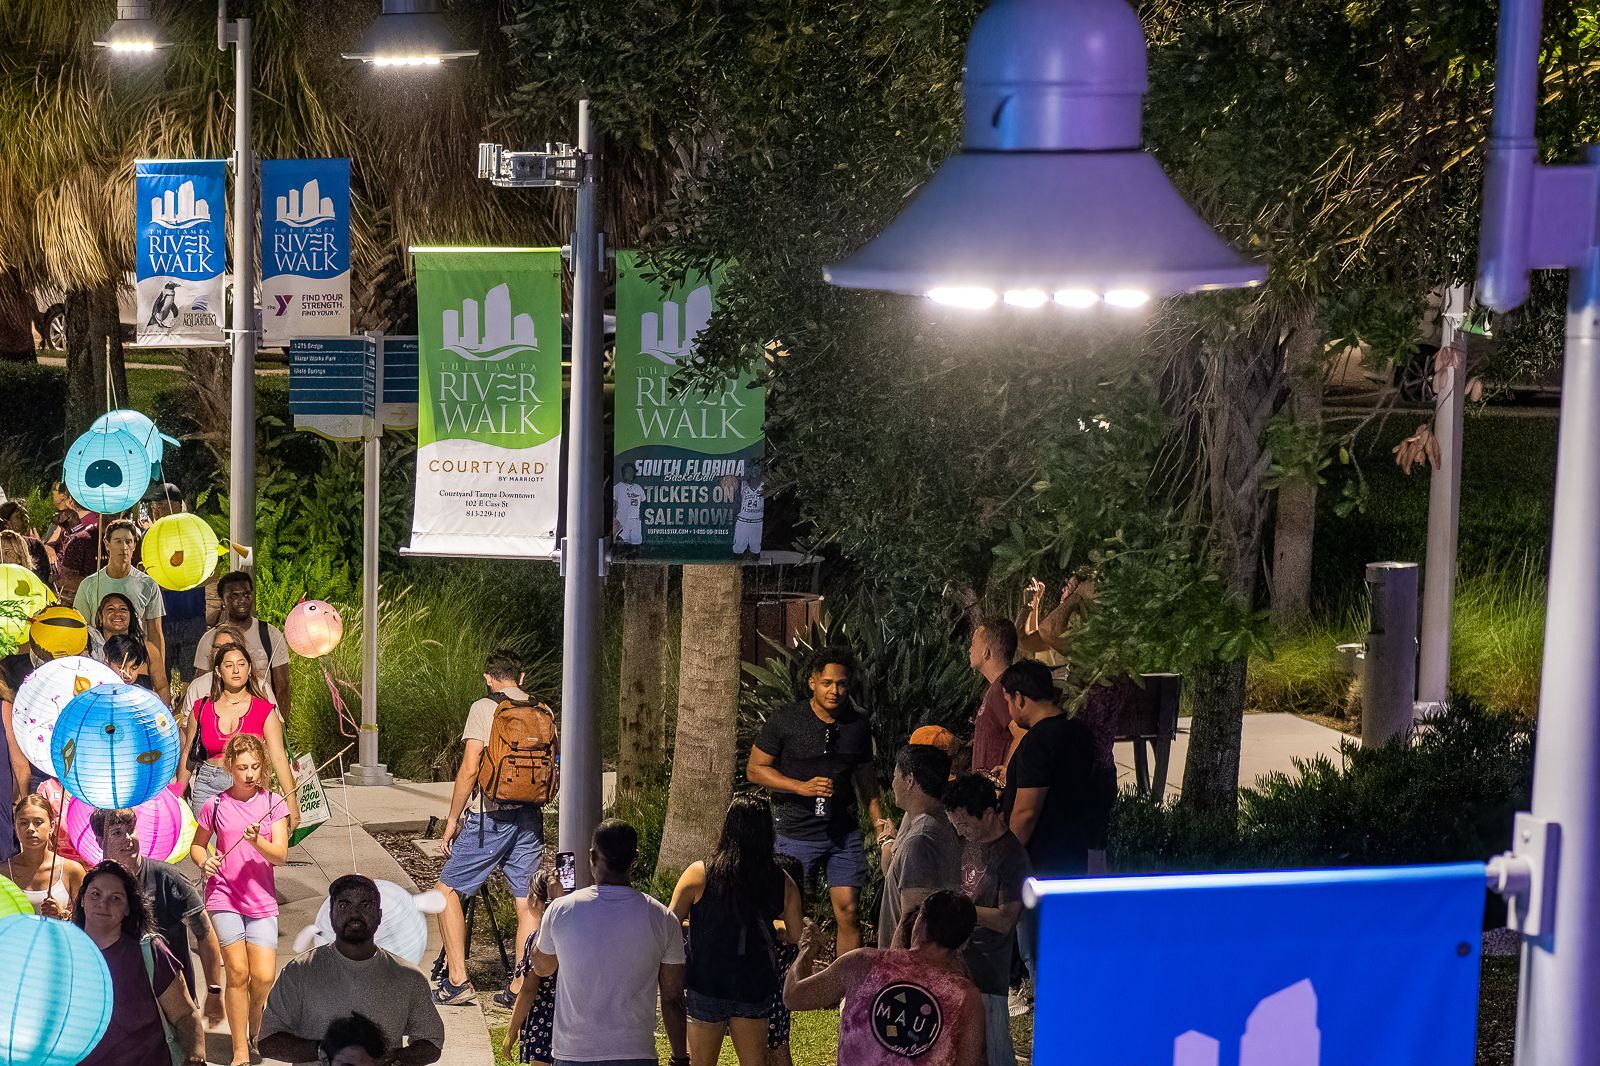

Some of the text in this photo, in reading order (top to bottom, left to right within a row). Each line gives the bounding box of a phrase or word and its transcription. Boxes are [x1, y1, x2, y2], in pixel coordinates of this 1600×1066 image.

[149, 234, 214, 254] RIVER
[274, 234, 339, 253] RIVER
[149, 252, 214, 273] WALK
[274, 251, 340, 272] WALK
[301, 301, 345, 309] STRENGTH.
[321, 293, 343, 301] YOUR
[440, 362, 537, 371] THE TAMPA
[440, 372, 544, 403] RIVER
[439, 402, 544, 434] WALK
[636, 408, 746, 439] WALK
[429, 460, 545, 475] COURTYARD
[635, 459, 745, 477] SOUTH FLORIDA
[439, 490, 535, 499] Courtyard Tampa Downtown
[644, 485, 735, 503] TICKETS ON
[644, 508, 734, 525] SALE NOW!
[300, 790, 320, 803] GOOD
[301, 800, 321, 813] CARE
[876, 1002, 937, 1038] MAUI
